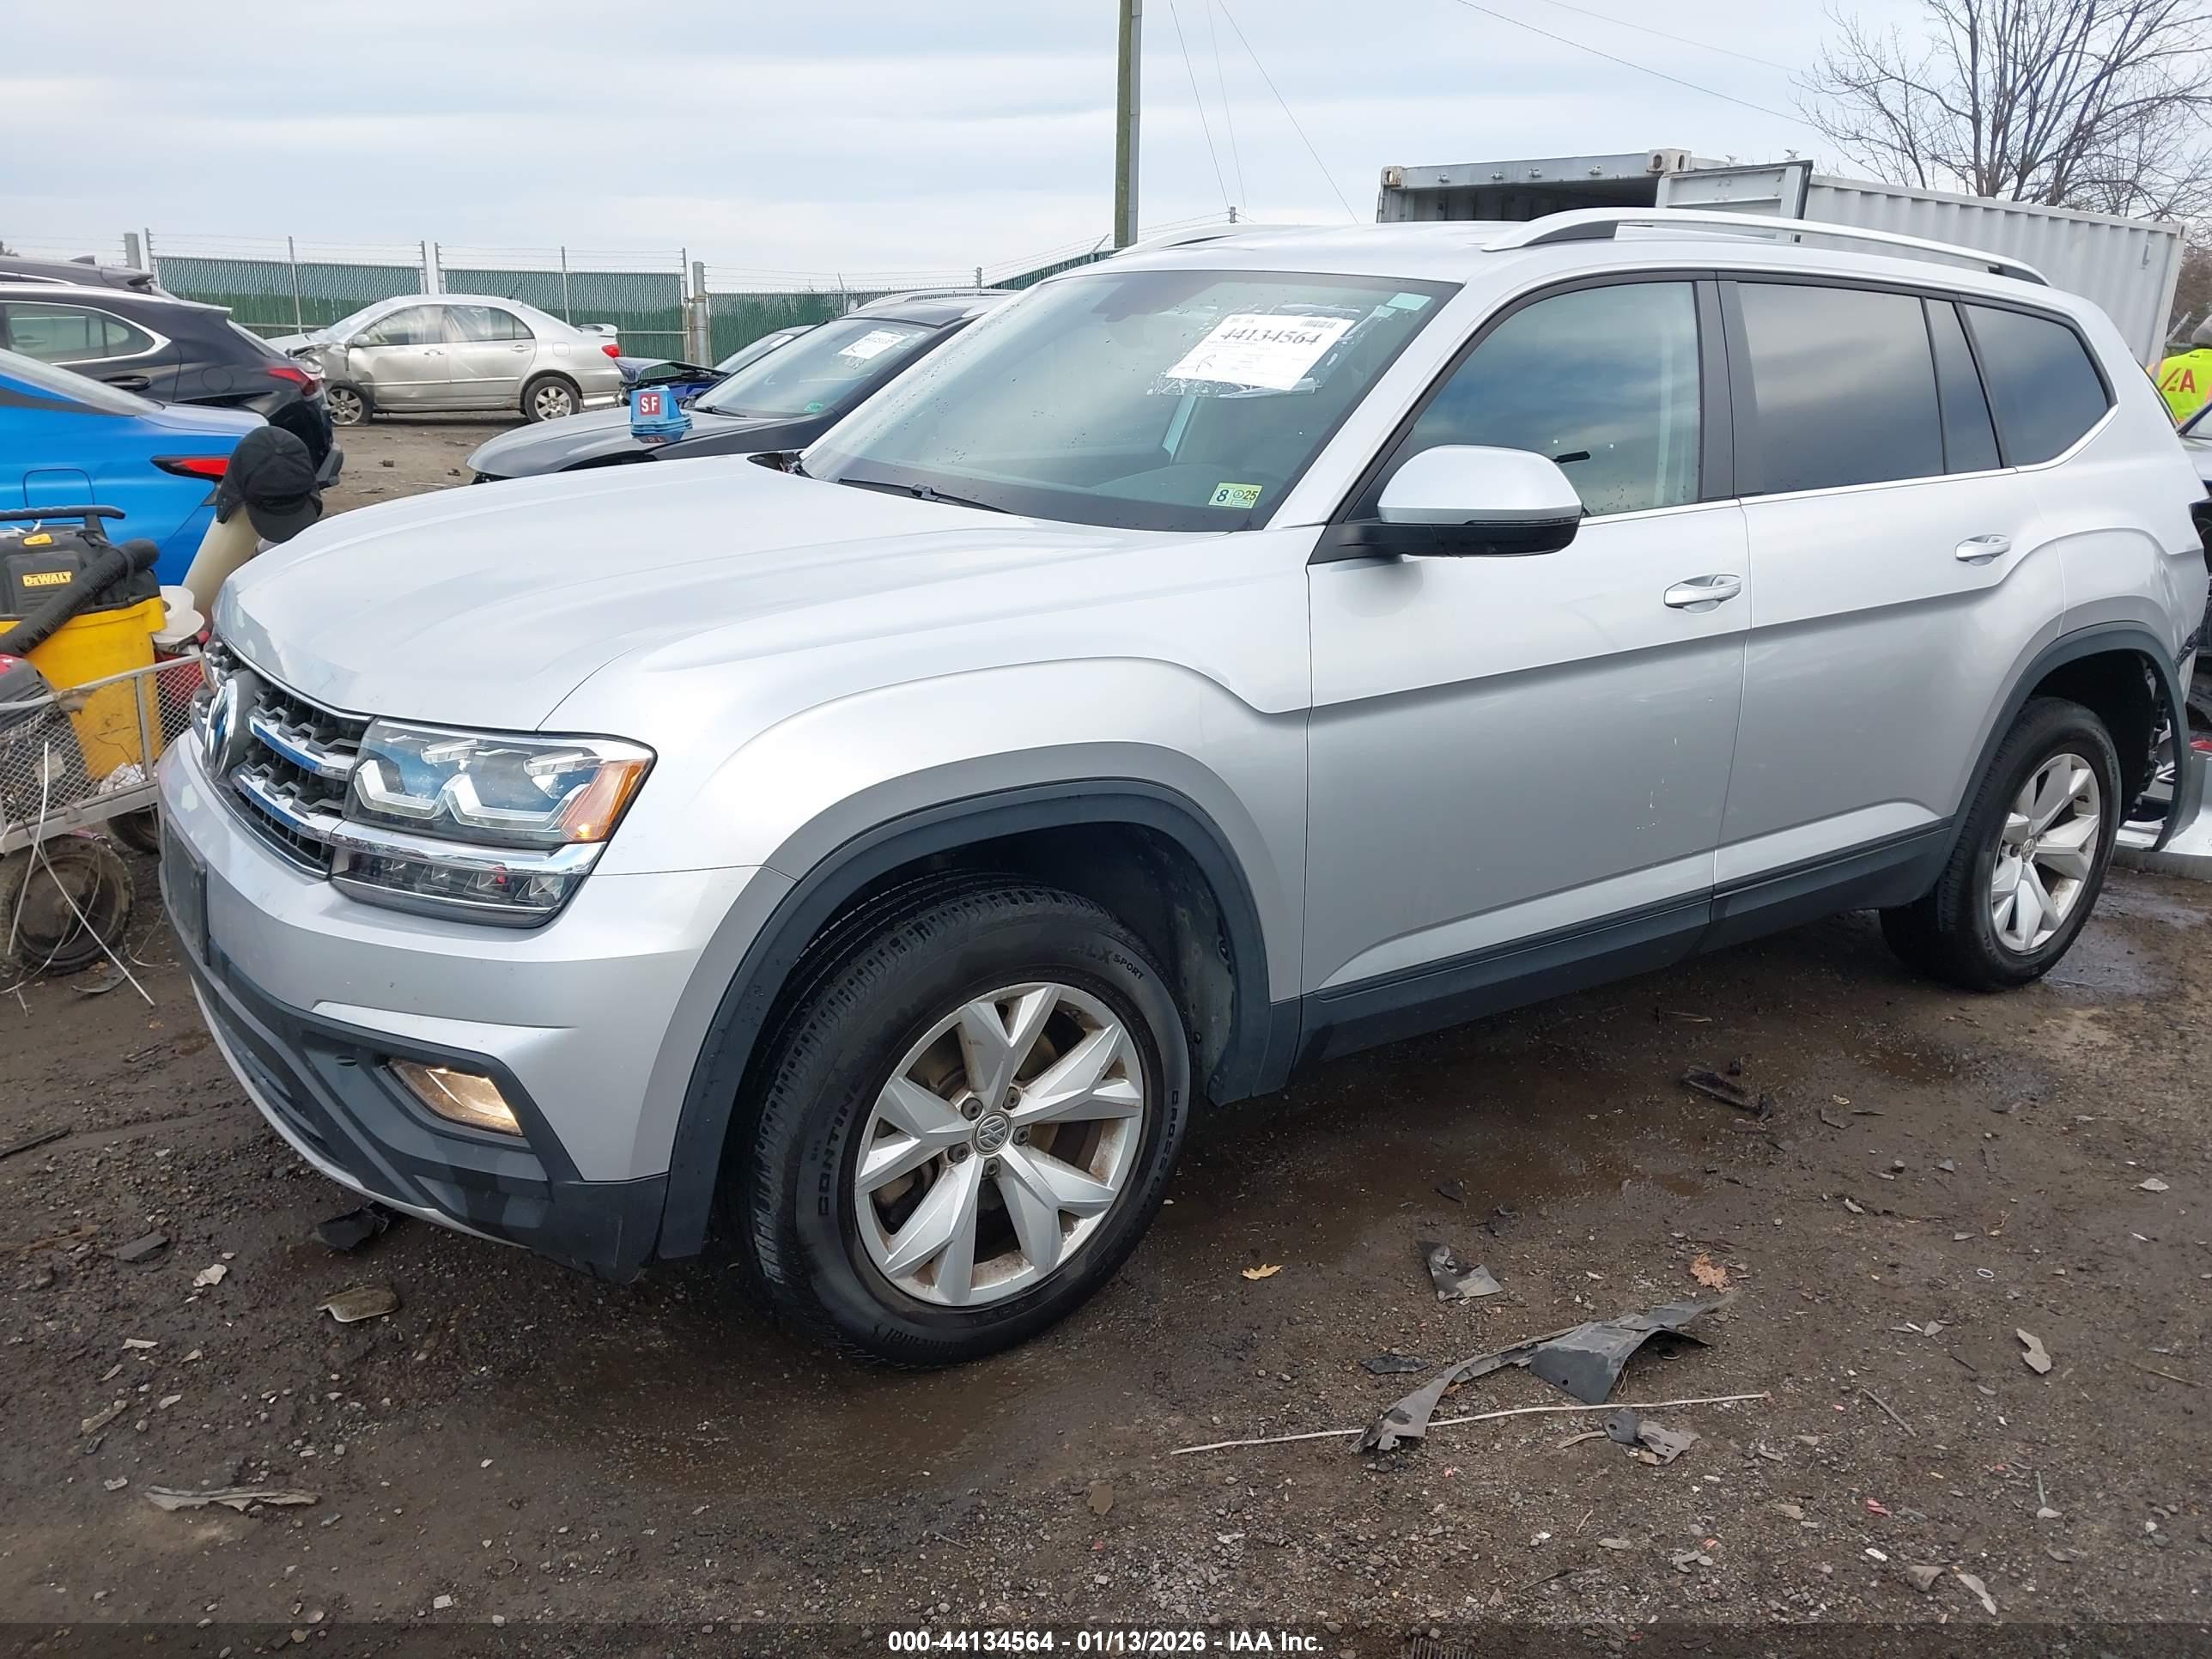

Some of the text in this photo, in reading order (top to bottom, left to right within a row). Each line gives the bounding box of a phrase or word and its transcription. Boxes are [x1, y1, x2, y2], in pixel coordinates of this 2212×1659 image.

[1219, 327, 1322, 345] 44134564
[641, 396, 659, 413] SF
[1216, 489, 1259, 502] 8 25
[1113, 953, 1145, 981] SPORT
